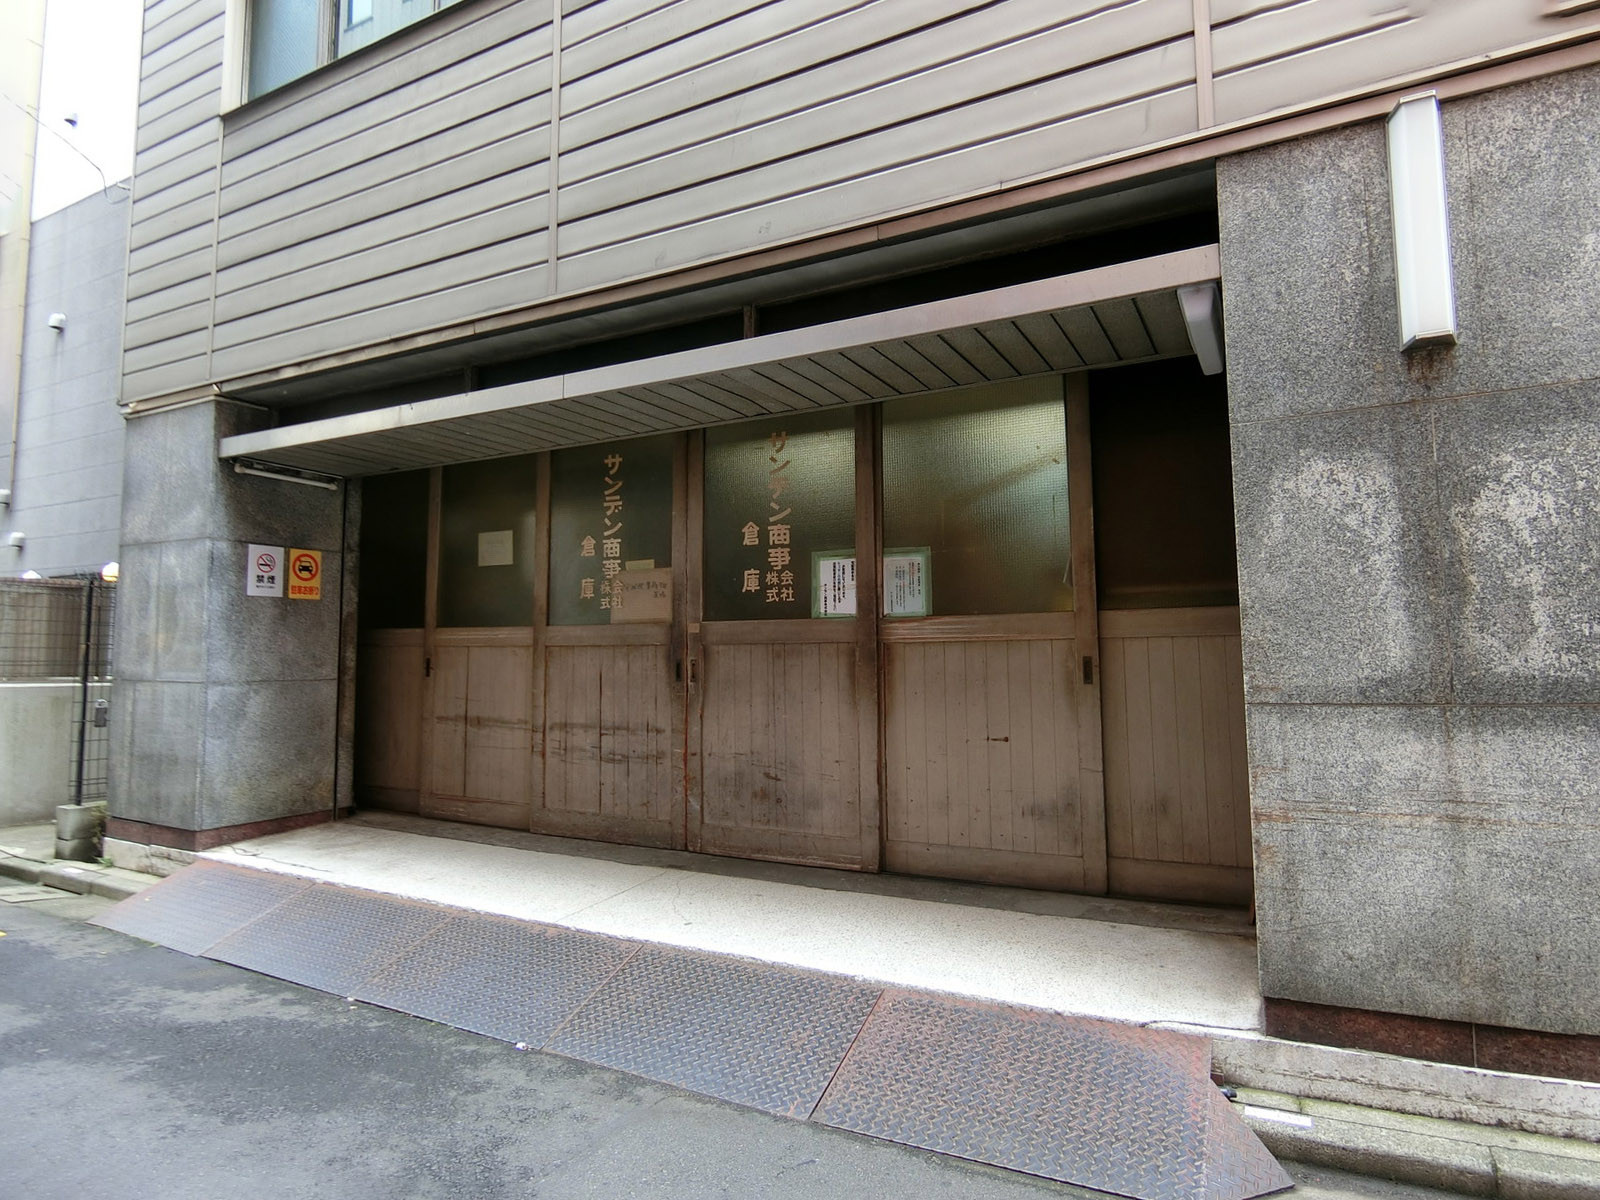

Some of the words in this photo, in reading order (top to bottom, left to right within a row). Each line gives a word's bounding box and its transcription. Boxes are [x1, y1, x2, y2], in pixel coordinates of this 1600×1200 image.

[580, 535, 597, 600] 倉庫
[742, 521, 761, 593] 倉庫
[256, 574, 275, 584] 禁煙
[291, 585, 319, 595] 駐車お断り
